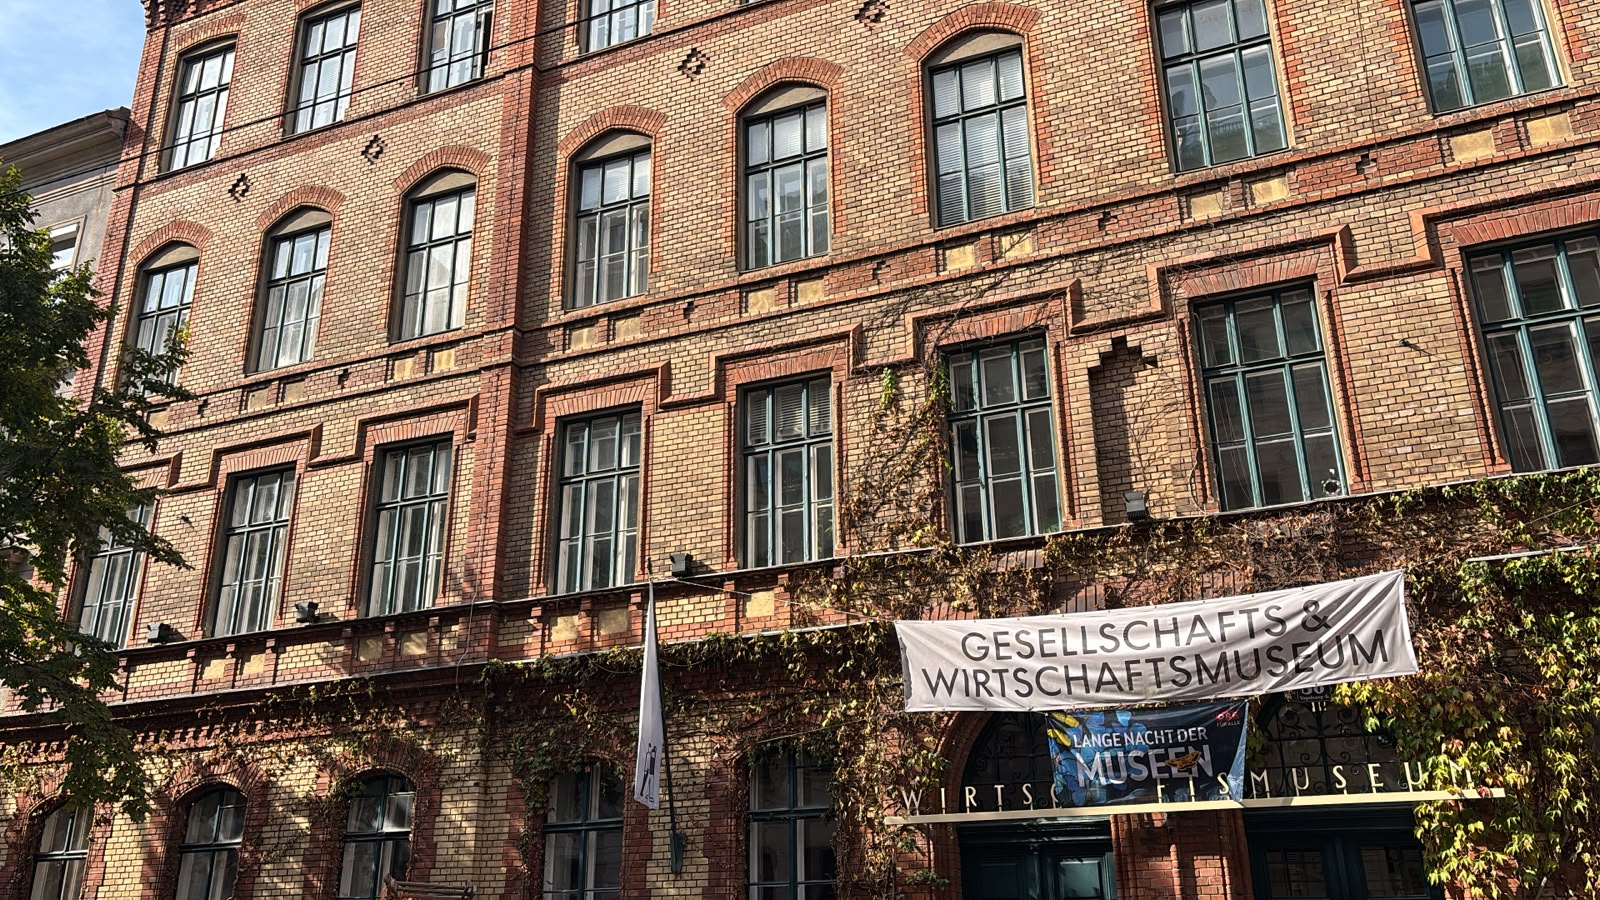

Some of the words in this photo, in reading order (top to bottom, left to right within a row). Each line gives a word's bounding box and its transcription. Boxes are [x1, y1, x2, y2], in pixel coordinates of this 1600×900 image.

[961, 605, 1287, 661] GESELLSCHAFTS
[1301, 600, 1331, 632] &
[922, 629, 1388, 698] WIRTSCHAFTSMUSEUM
[1073, 732, 1121, 748] LANGE
[1124, 729, 1178, 746] NACHT
[1177, 726, 1209, 742] DER
[1076, 744, 1214, 787] MUSEEN
